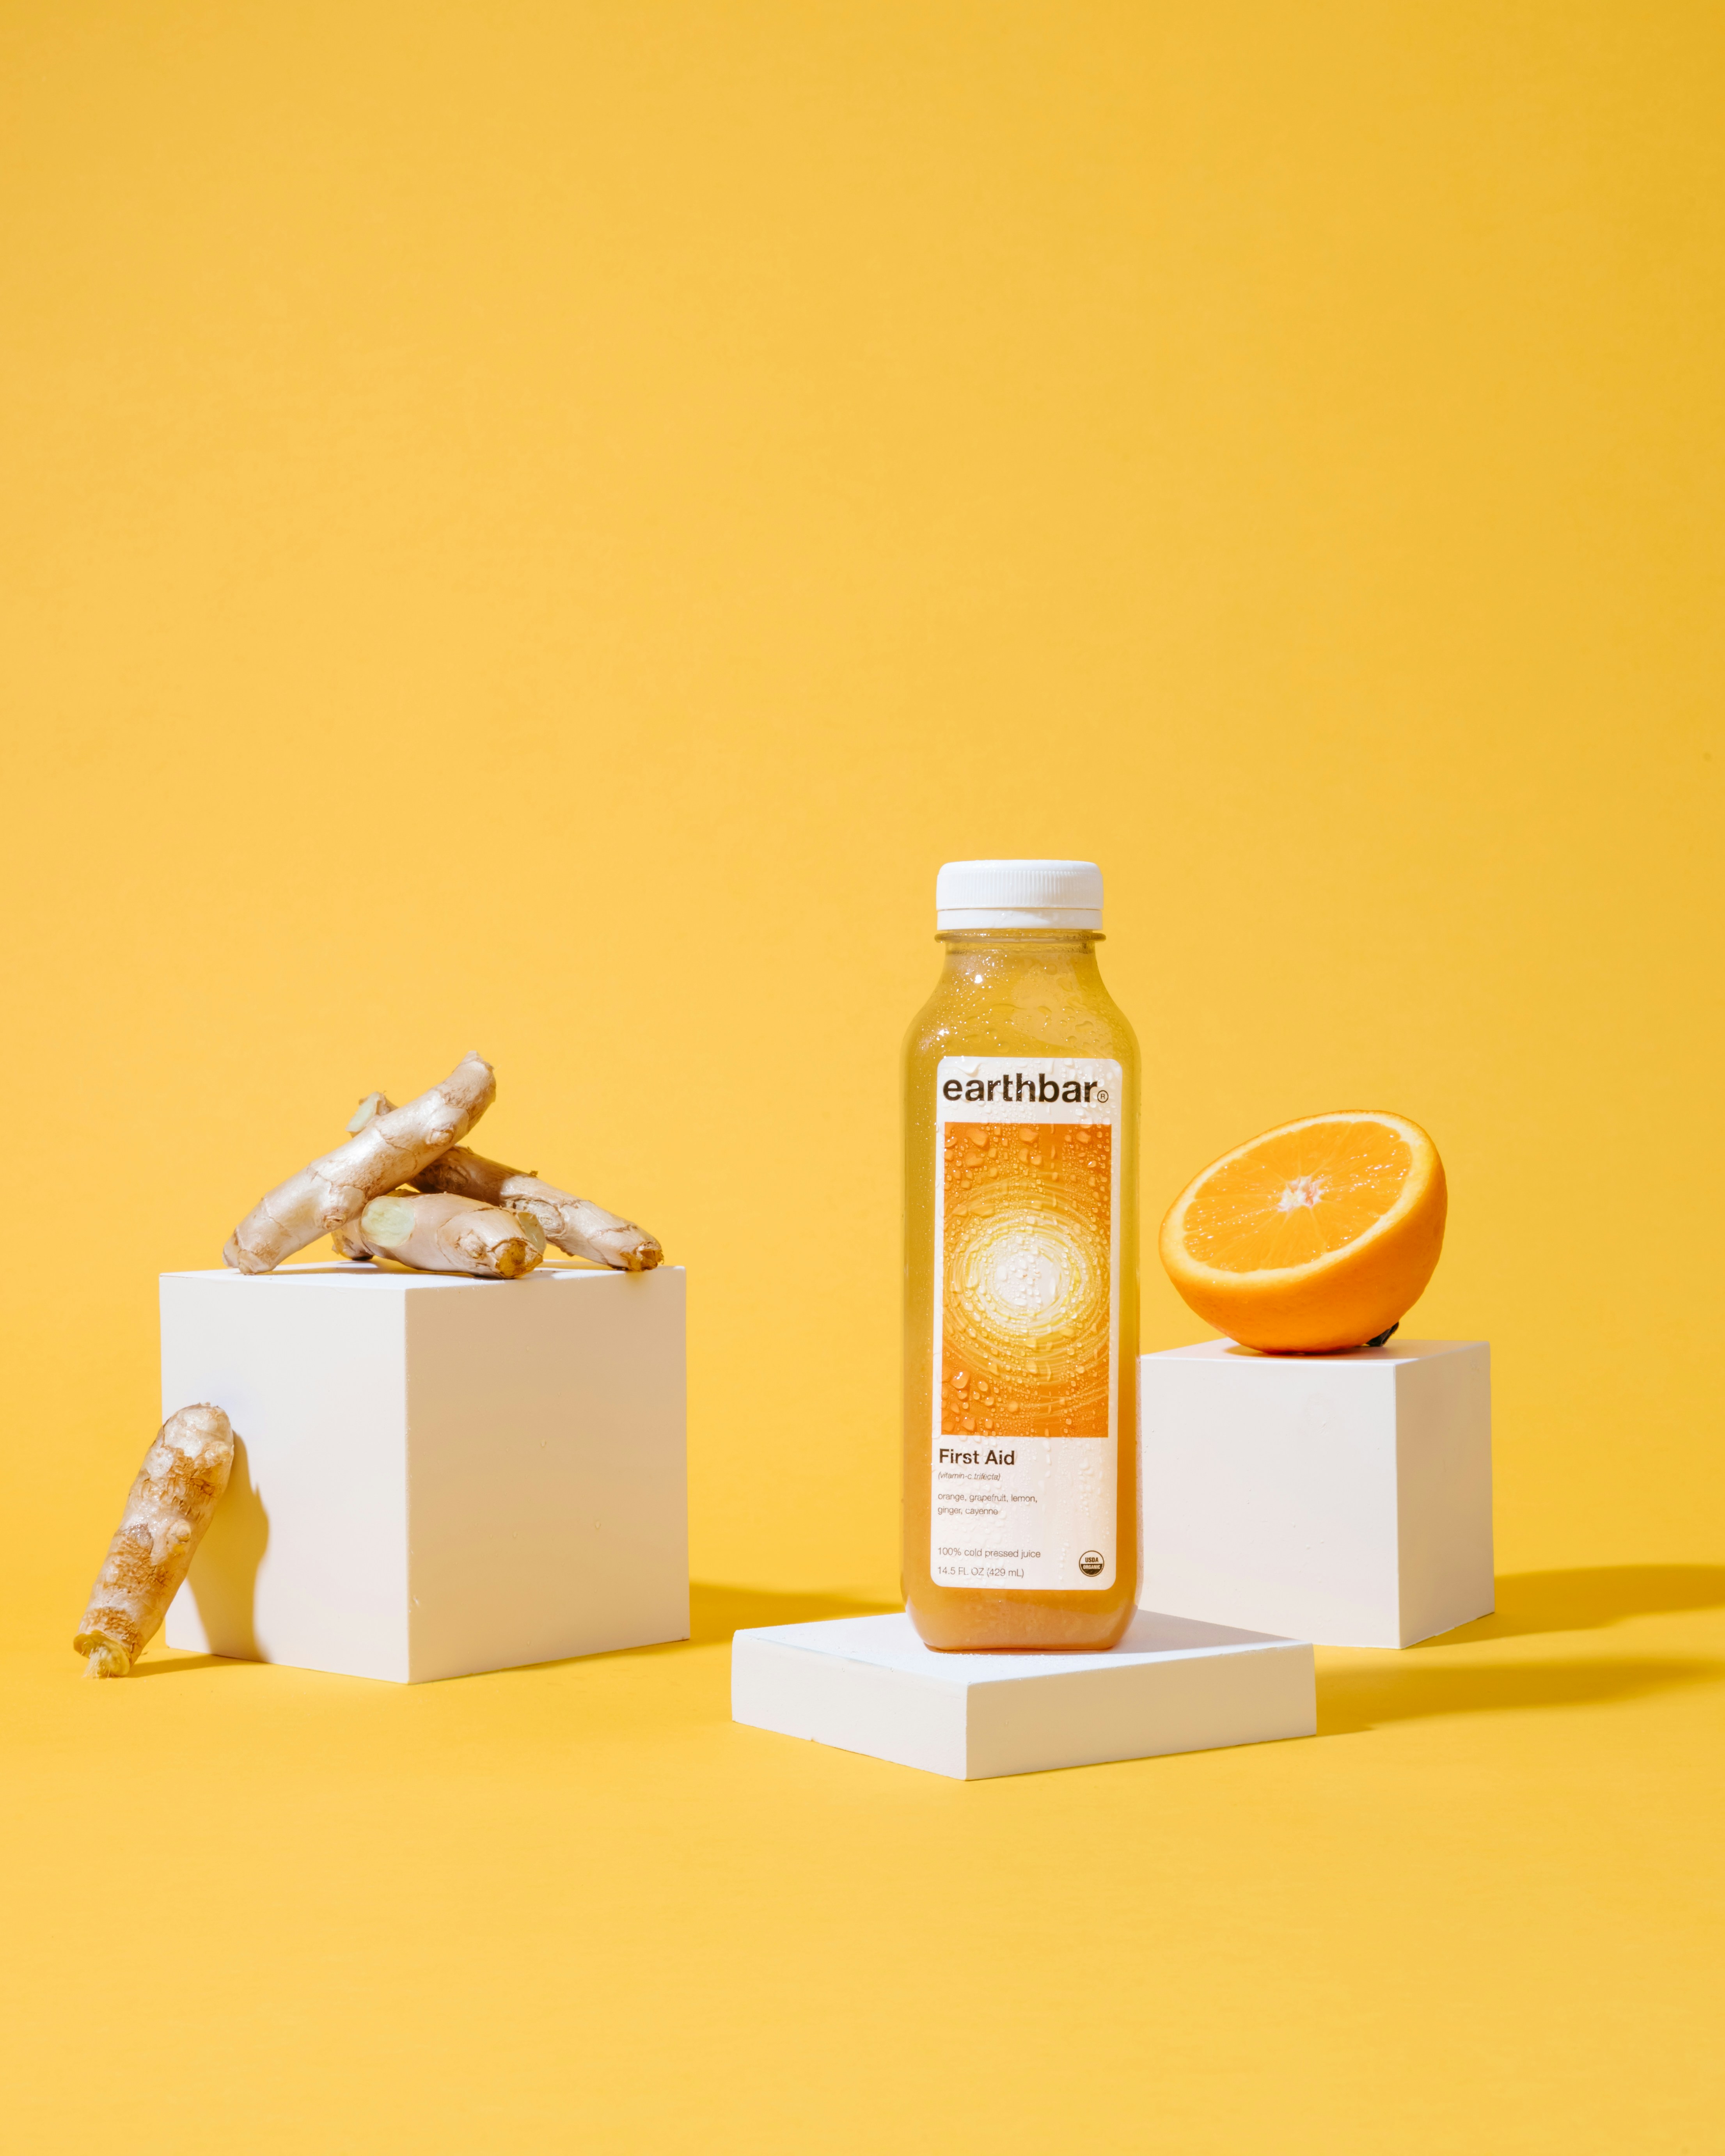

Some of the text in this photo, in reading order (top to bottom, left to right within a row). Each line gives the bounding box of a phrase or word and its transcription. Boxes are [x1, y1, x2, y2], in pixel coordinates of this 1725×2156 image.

[940, 1448, 1015, 1465] First Aid
[1011, 1494, 1037, 1503] lemon,
[938, 1506, 998, 1516] ginger, cayenne
[938, 1547, 961, 1556] 100%
[985, 1550, 1018, 1558] pressed
[1021, 1550, 1040, 1559] juice
[938, 1567, 955, 1575] 14.5
[971, 1567, 984, 1576] OZ
[987, 1568, 1005, 1578] (429
[1008, 1569, 1024, 1578] mL)
